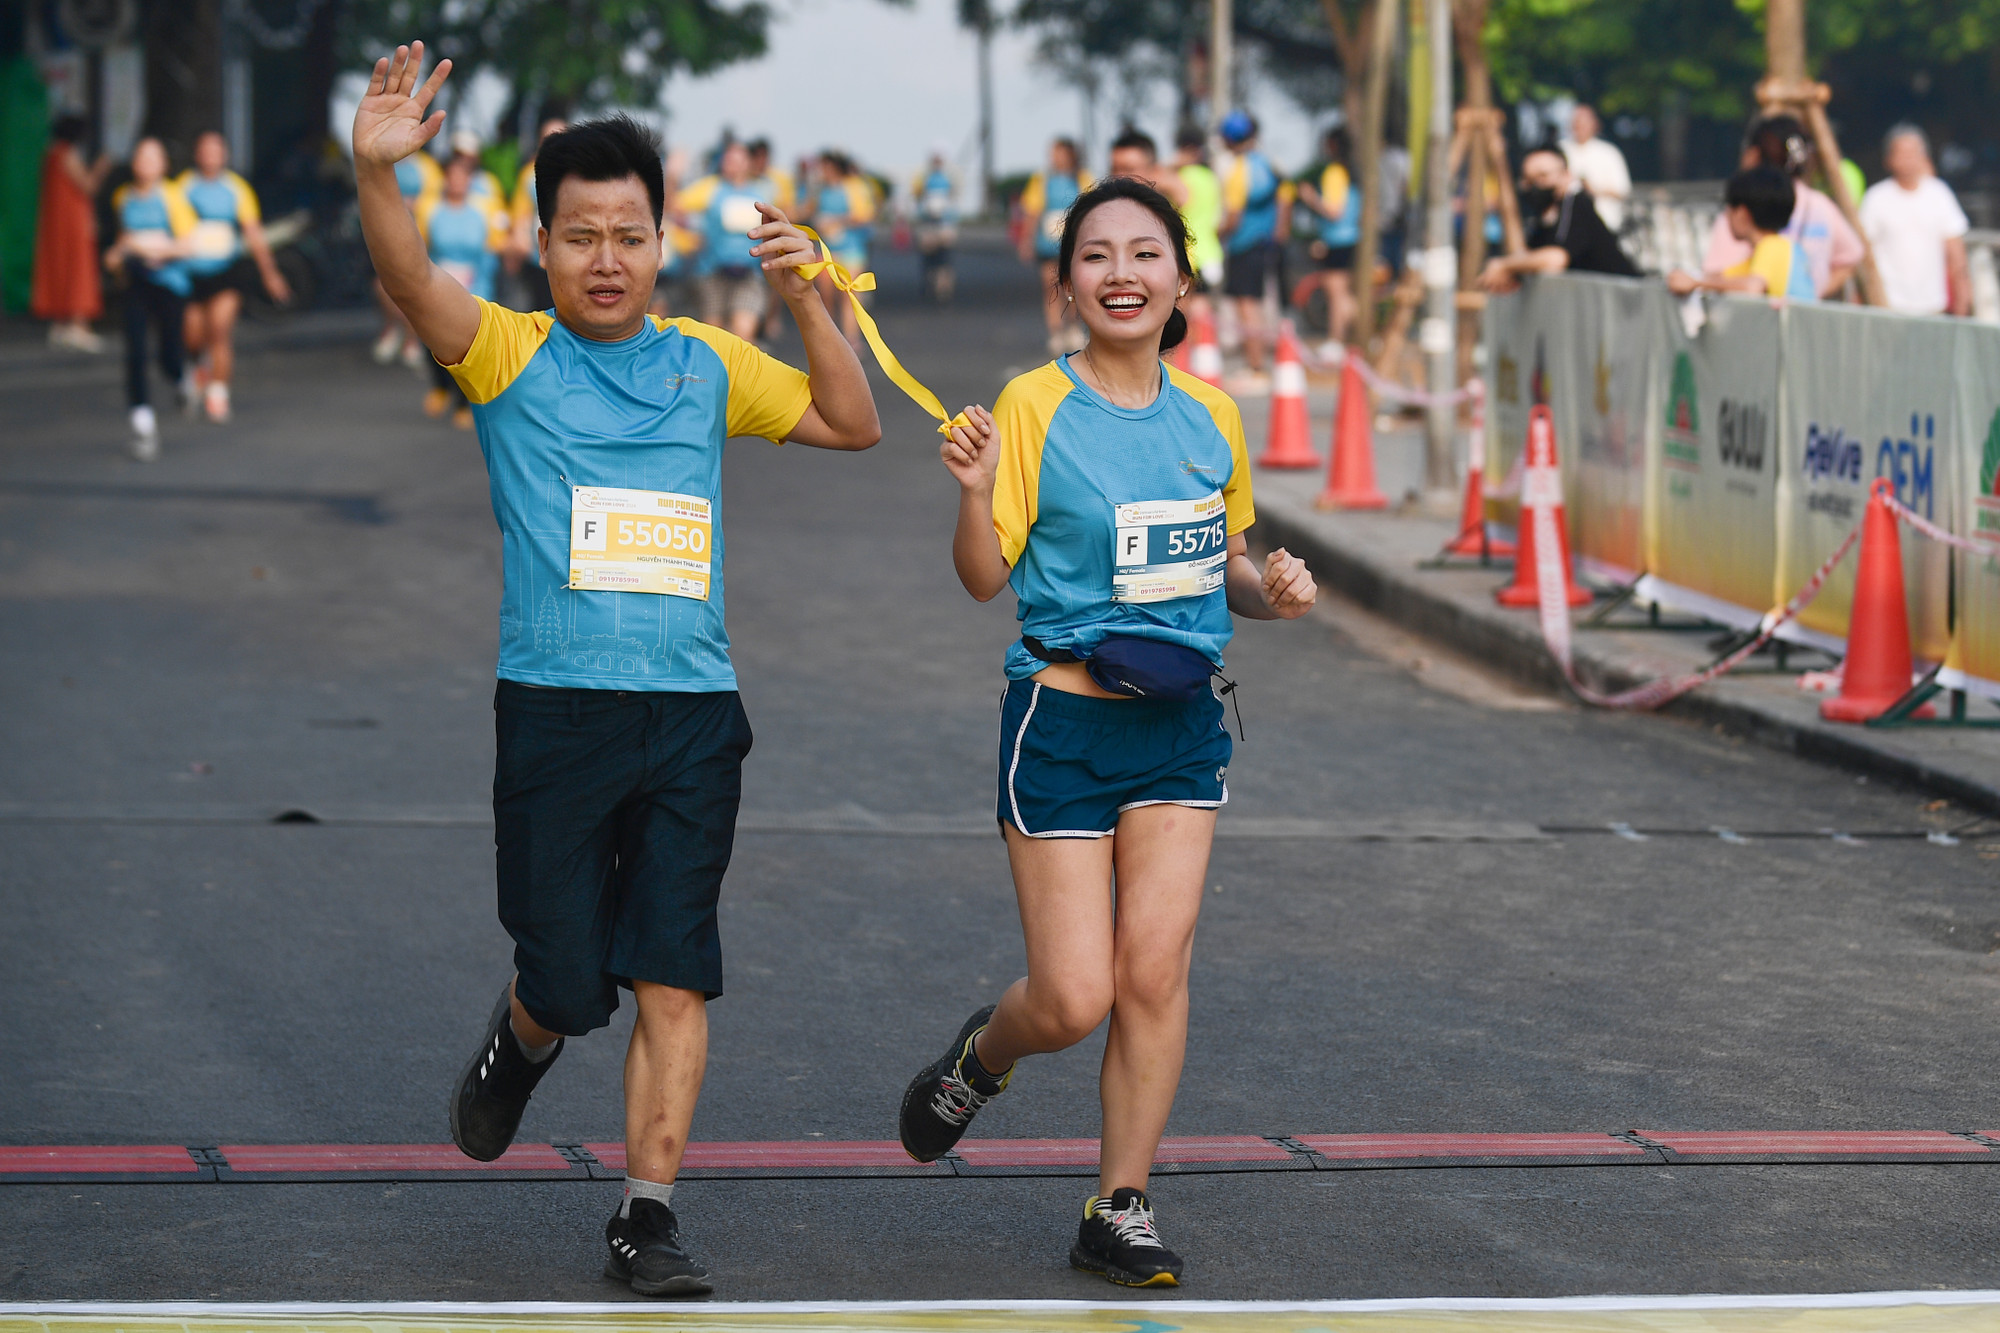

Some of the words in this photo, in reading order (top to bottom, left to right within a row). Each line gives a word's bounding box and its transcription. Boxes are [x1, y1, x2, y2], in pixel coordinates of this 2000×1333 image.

[584, 521, 597, 540] F
[617, 520, 705, 553] 55050
[1168, 520, 1224, 555] 55715
[1127, 535, 1139, 555] F
